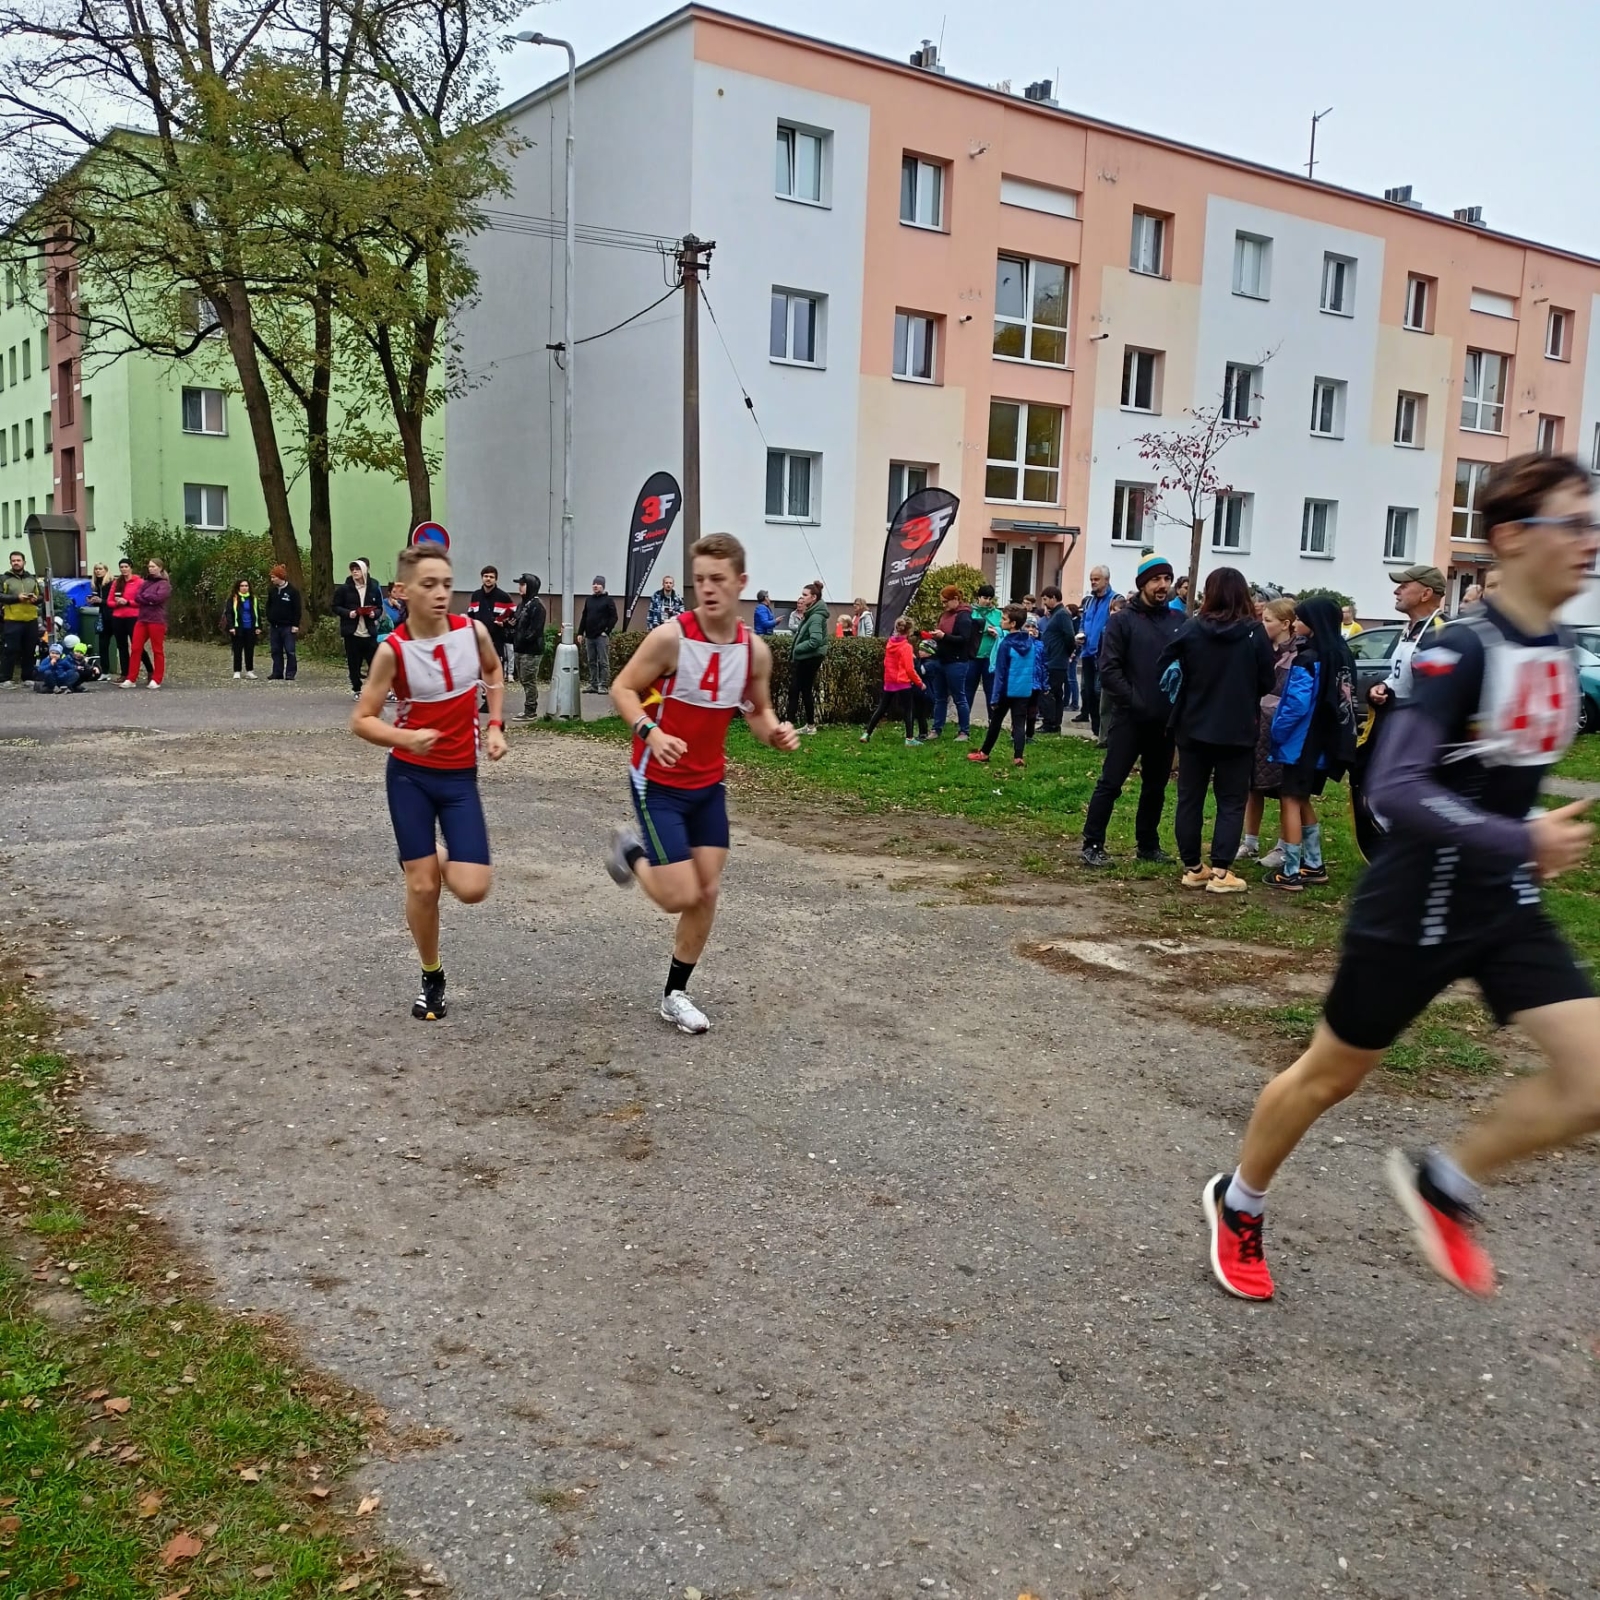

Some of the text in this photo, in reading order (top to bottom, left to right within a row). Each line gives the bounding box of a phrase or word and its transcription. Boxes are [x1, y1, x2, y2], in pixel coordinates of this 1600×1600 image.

[641, 493, 675, 524] 3F
[900, 506, 953, 550] 3F
[432, 644, 454, 692] 1
[699, 652, 720, 702] 4
[1393, 659, 1402, 680] 5
